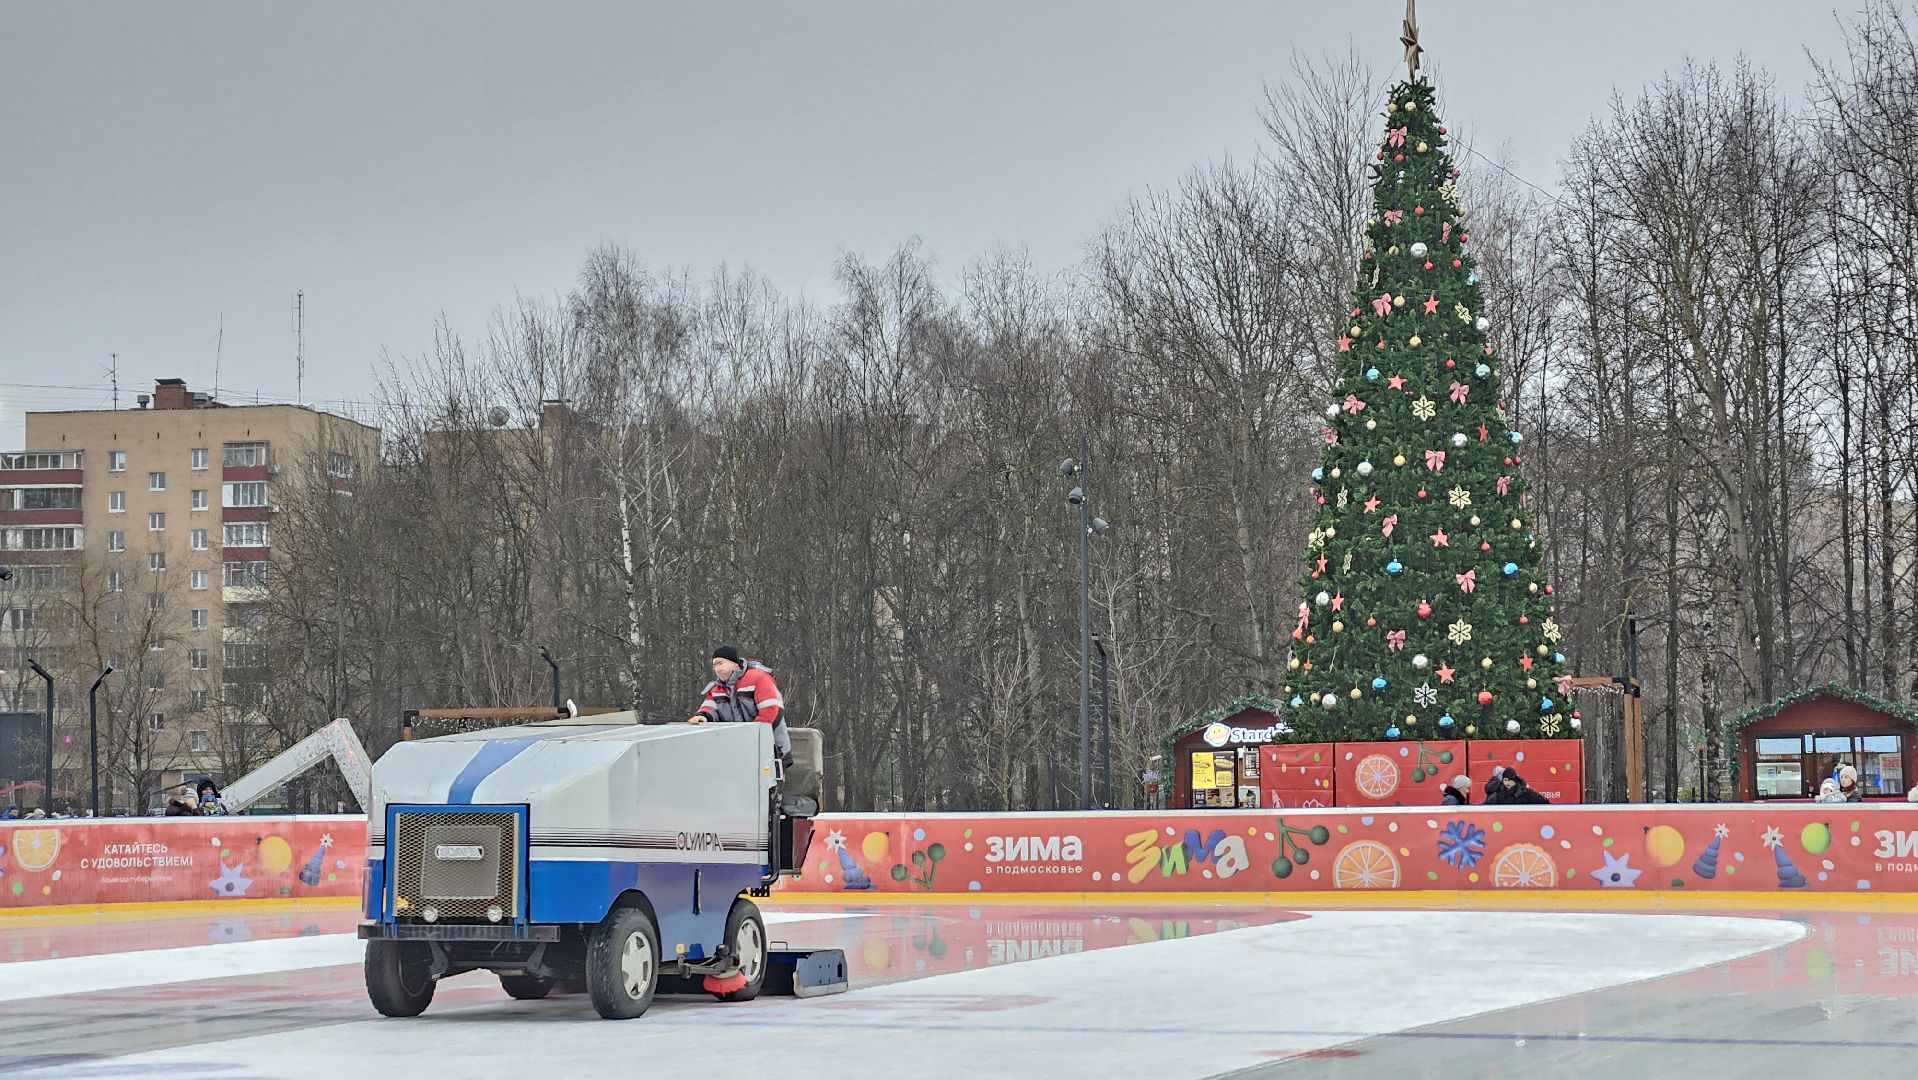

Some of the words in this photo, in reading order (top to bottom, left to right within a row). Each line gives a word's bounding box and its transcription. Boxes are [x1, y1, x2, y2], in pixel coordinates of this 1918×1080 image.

[1231, 727, 1285, 742] Stard
[104, 842, 168, 855] КАТАЙТЕСЬ
[677, 831, 723, 852] OLYMPIA
[80, 858, 89, 869] С
